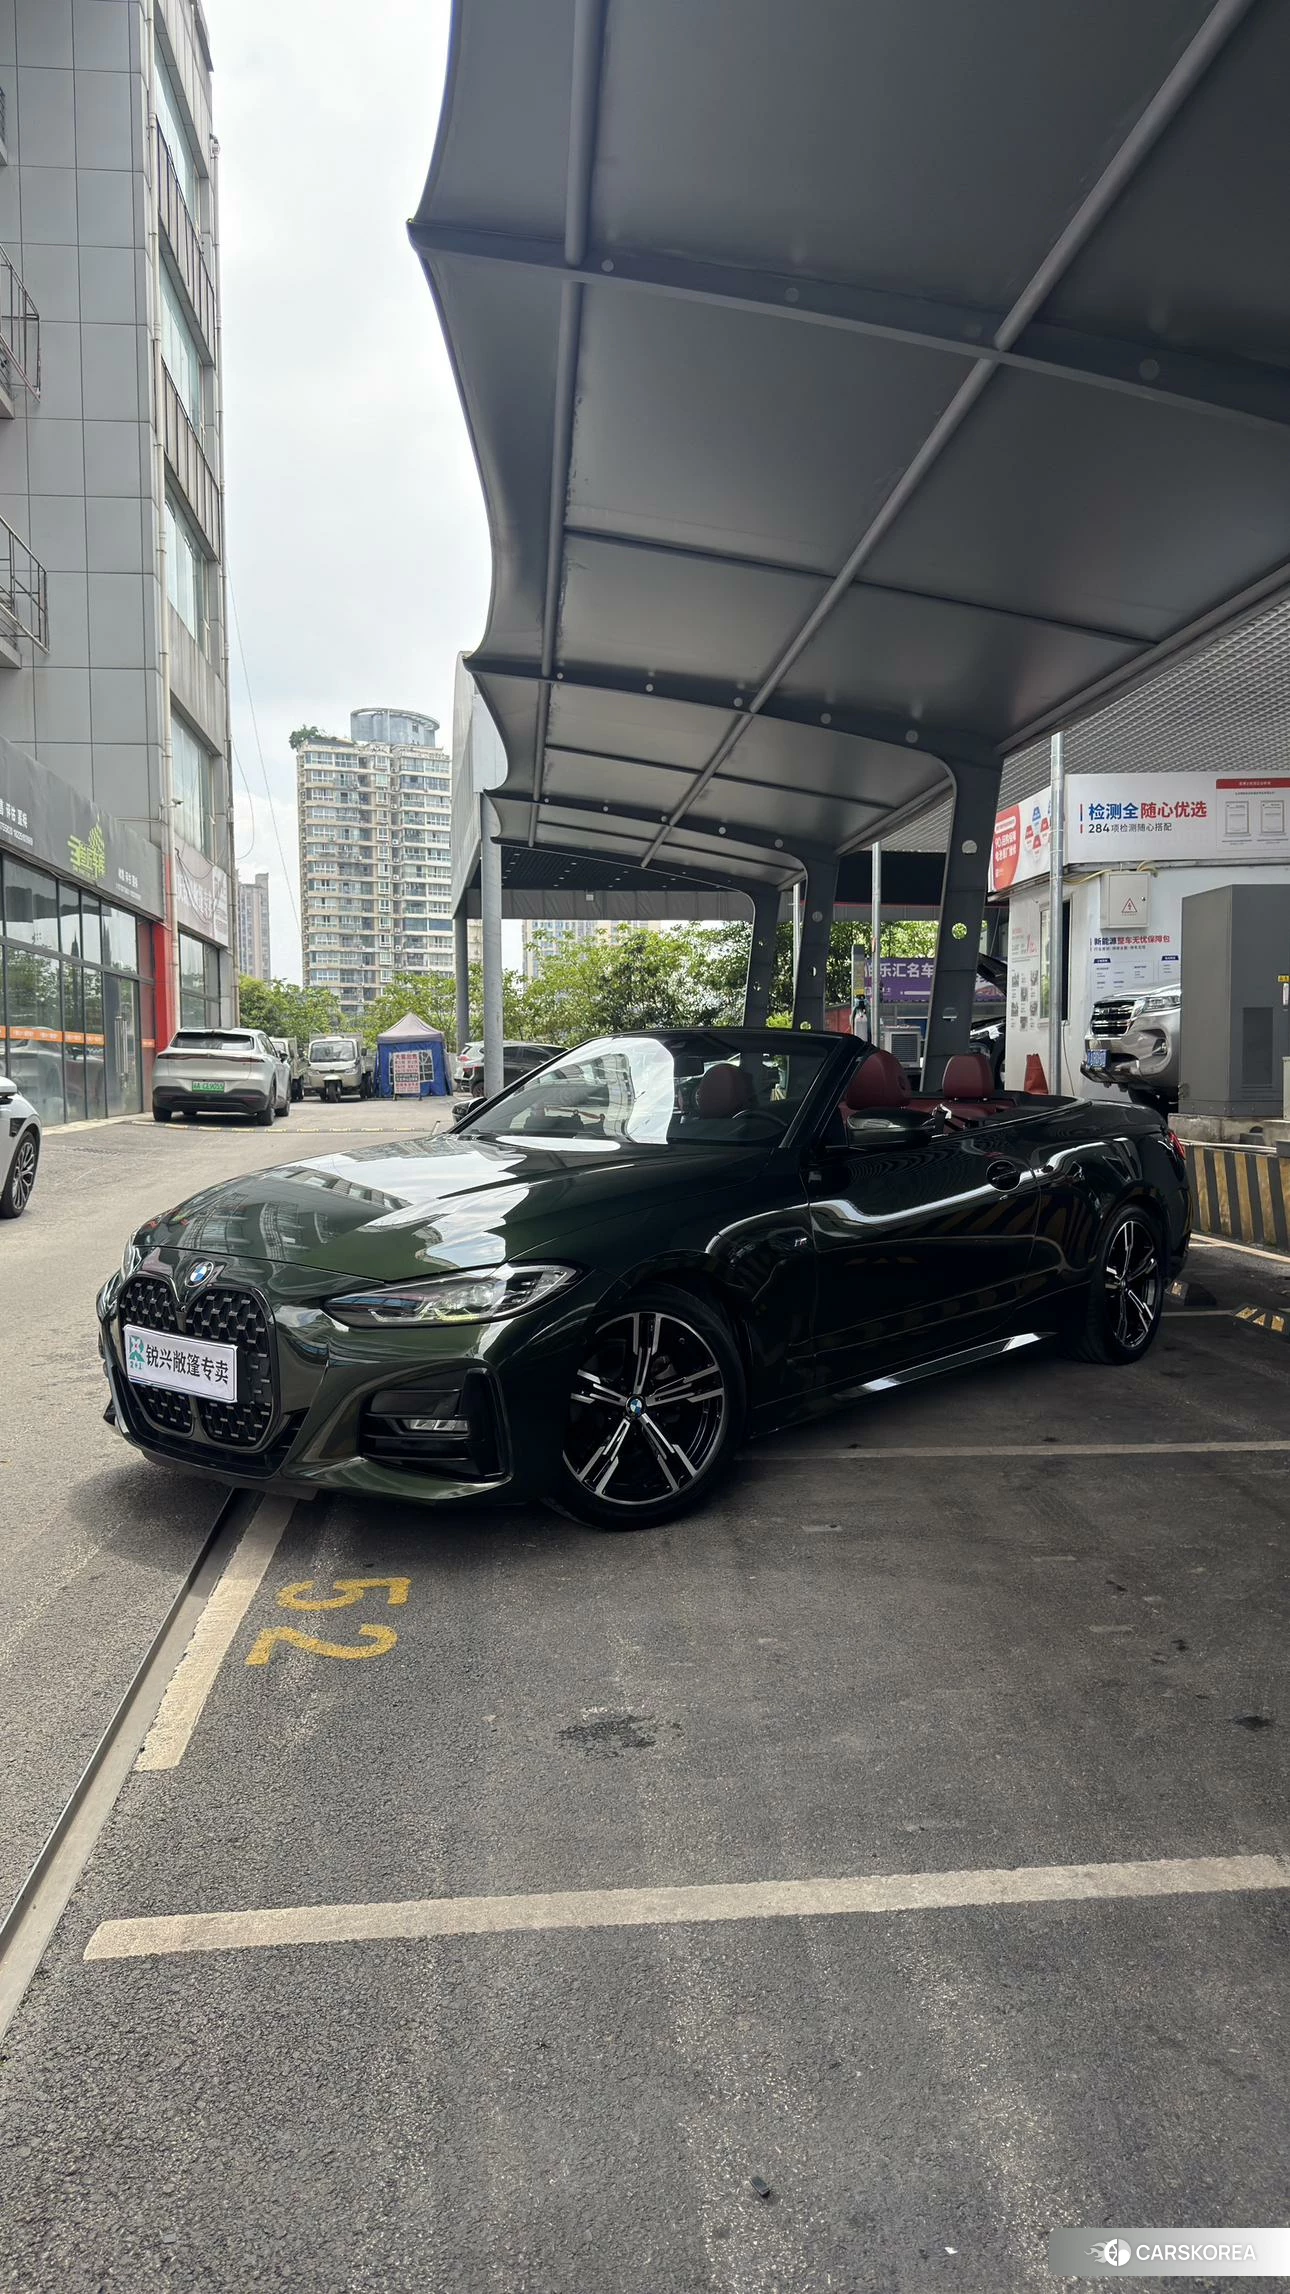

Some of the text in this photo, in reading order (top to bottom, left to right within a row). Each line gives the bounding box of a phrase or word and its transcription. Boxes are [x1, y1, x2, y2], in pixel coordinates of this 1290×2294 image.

[1088, 800, 1208, 820] 检测全随心优选
[146, 1344, 229, 1385] 锐兴敞篷专卖
